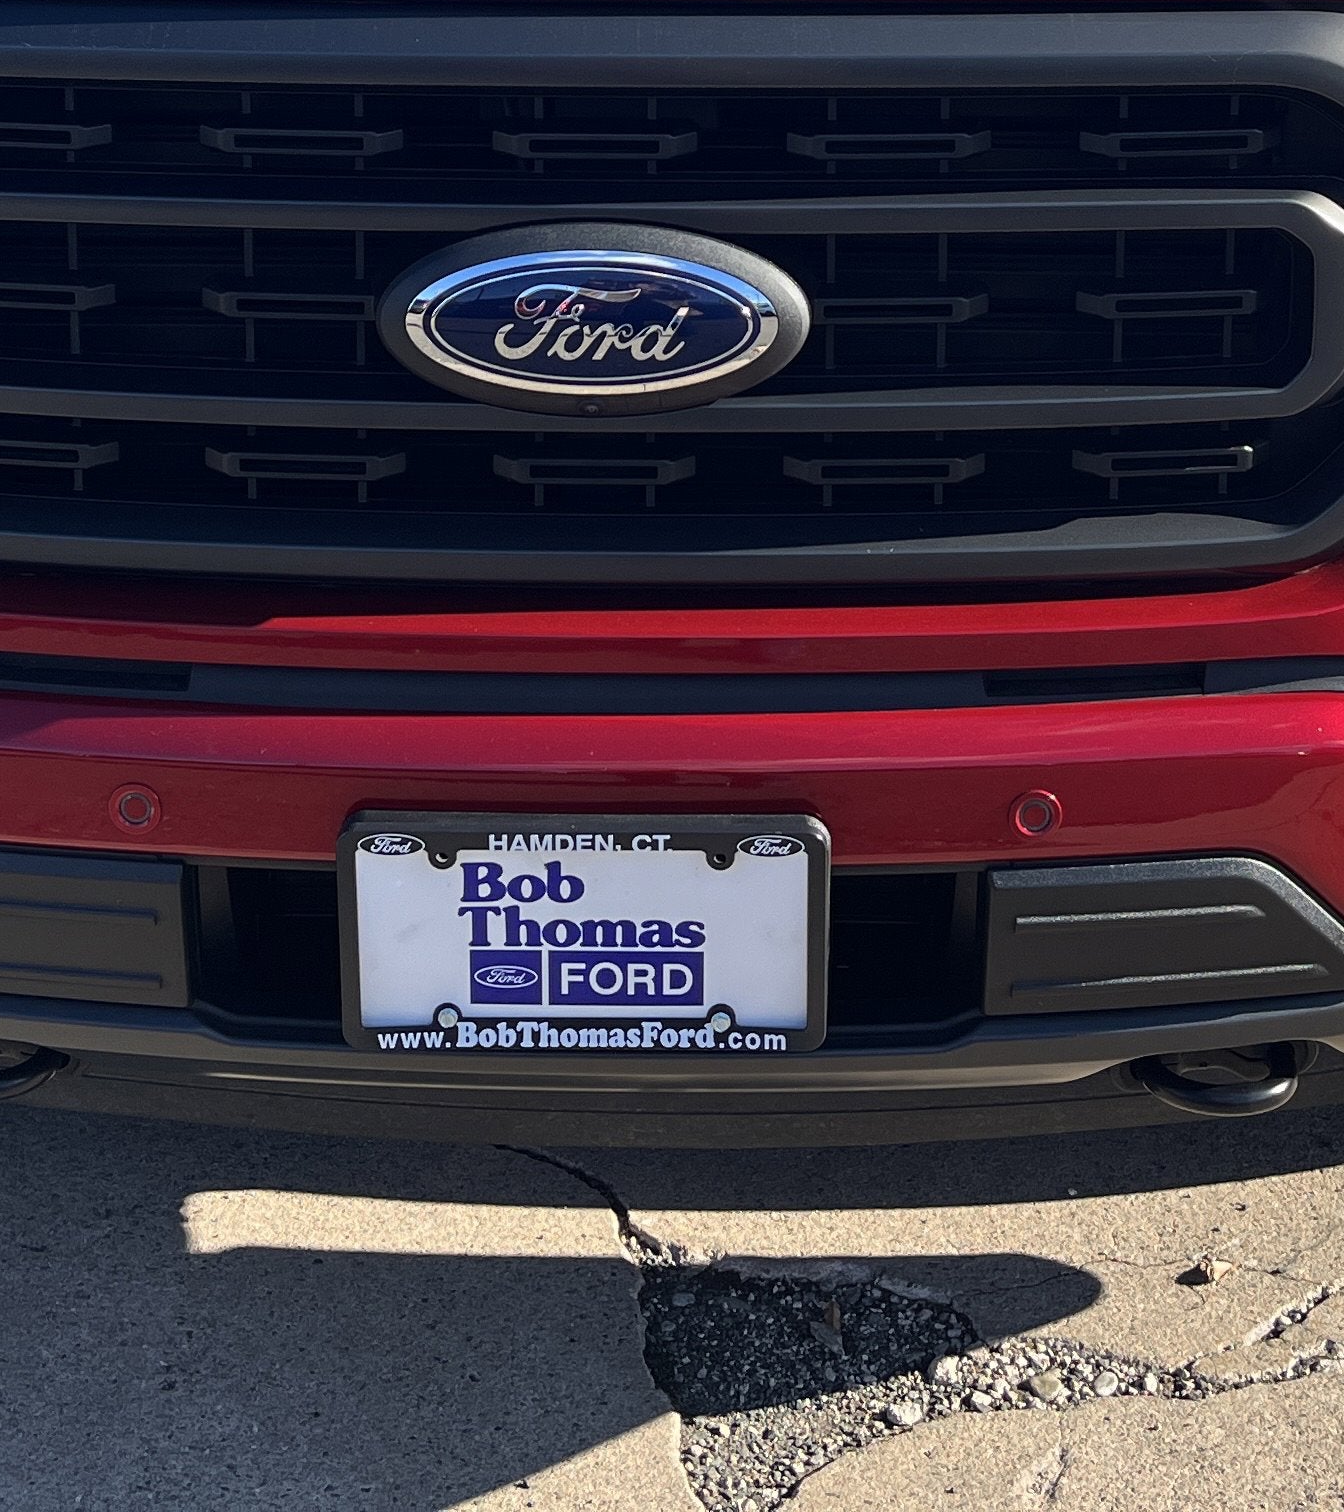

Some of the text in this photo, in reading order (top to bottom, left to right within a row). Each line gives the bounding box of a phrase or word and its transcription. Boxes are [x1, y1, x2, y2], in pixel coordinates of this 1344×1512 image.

[493, 283, 692, 362] Ford
[370, 836, 412, 854] Ford
[749, 838, 791, 855] Ford
[460, 860, 585, 903] Bob
[458, 904, 707, 948] Thomas
[486, 969, 526, 985] Ford
[560, 961, 694, 996] FORD
[377, 1021, 787, 1051] www.BobThomasFord.com
